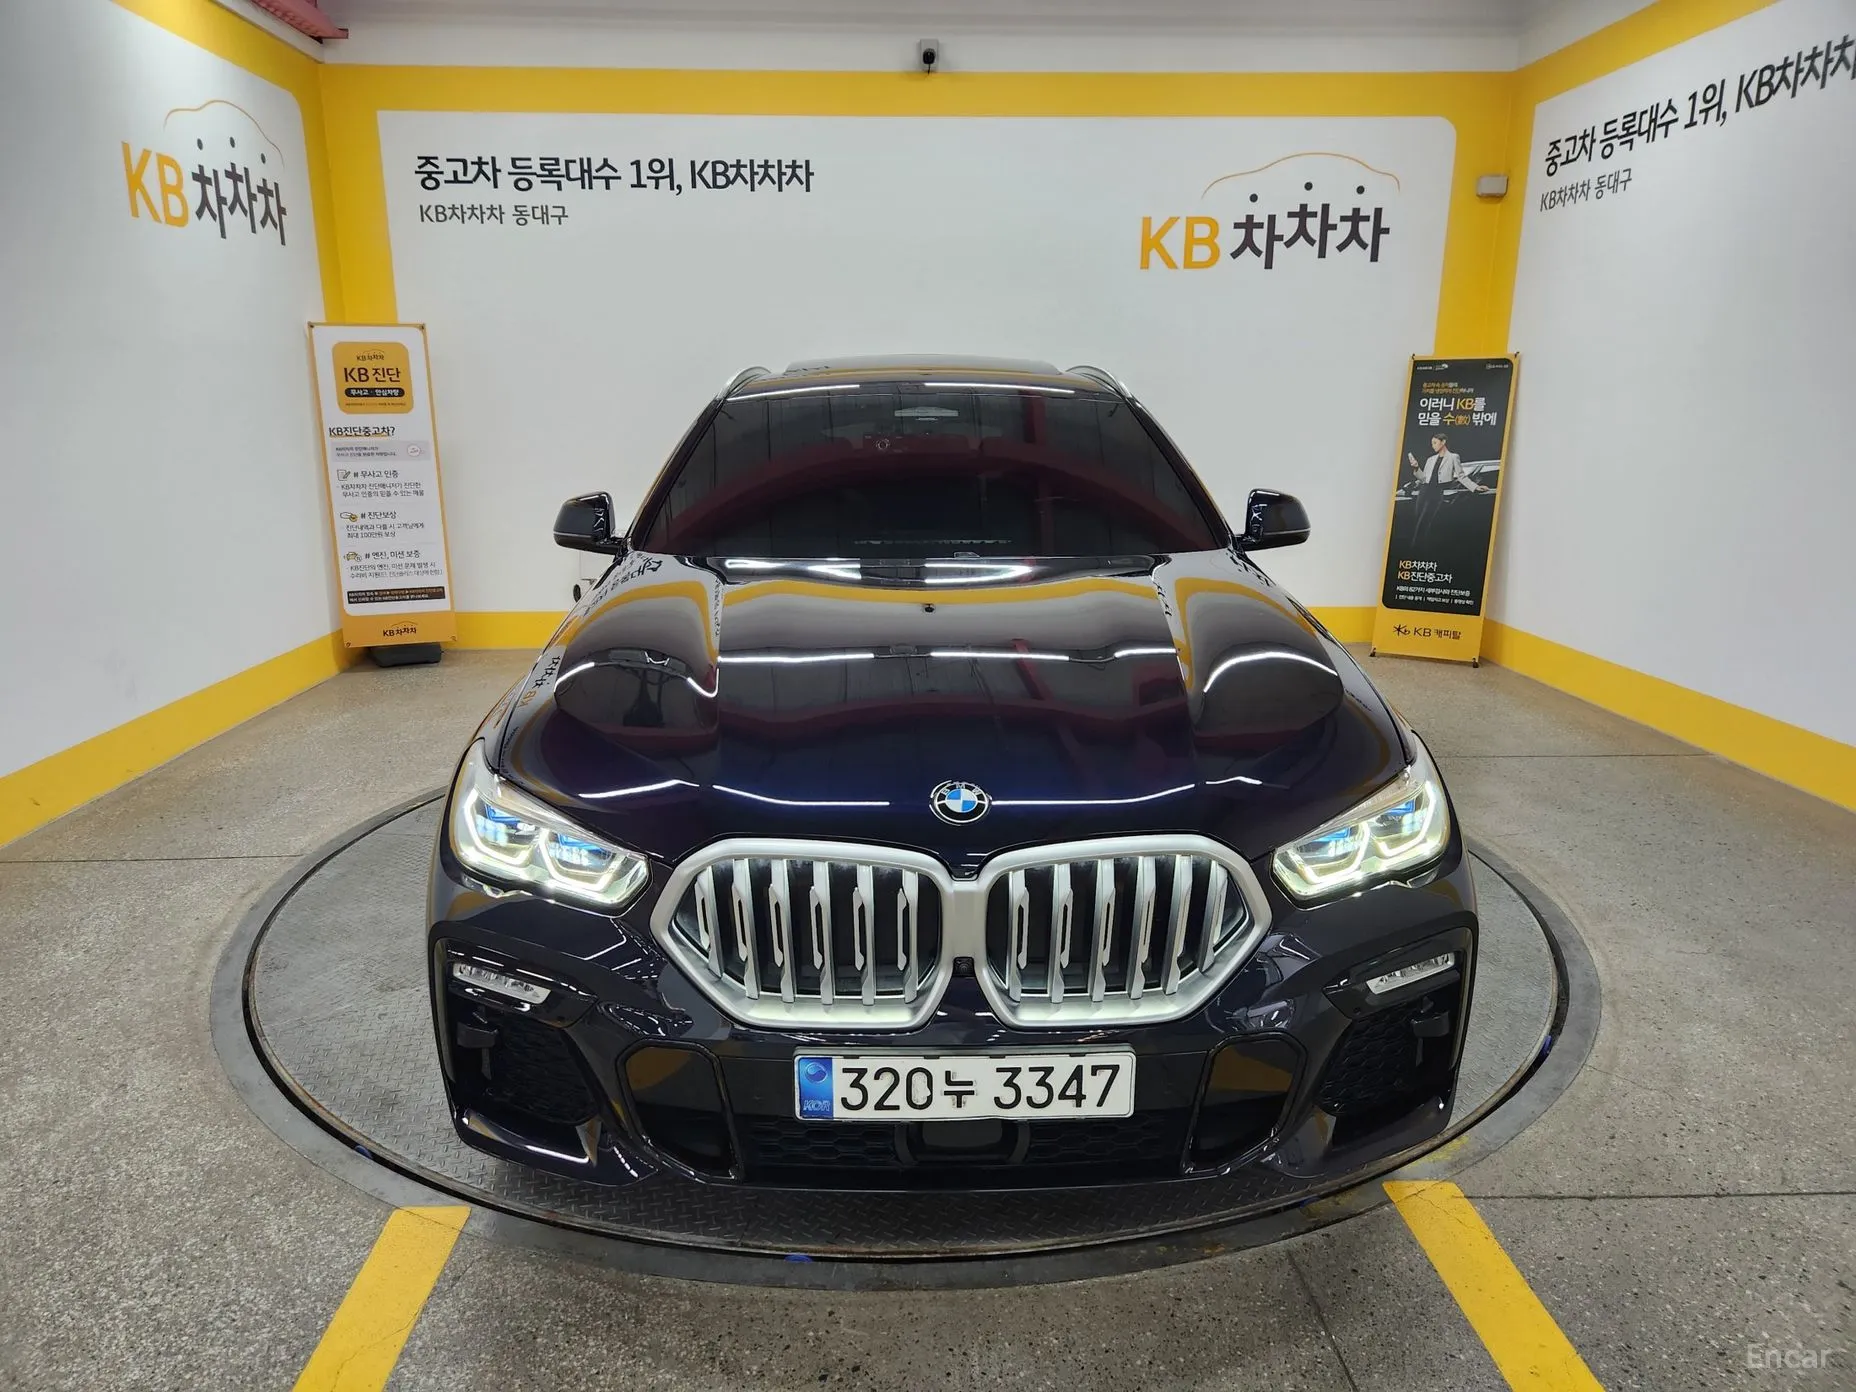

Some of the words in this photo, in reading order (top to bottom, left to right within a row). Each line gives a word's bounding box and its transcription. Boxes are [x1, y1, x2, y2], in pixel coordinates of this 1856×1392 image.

[1545, 125, 1596, 177] 중고차
[1600, 98, 1679, 160] 등록대수
[1683, 78, 1727, 127] 1위,
[414, 156, 502, 191] 중고차
[508, 157, 622, 192] 등록대수
[630, 157, 682, 195] 1위,
[690, 159, 815, 193] KB차차차
[1539, 179, 1591, 212] KB차차차
[1595, 167, 1633, 201] 동대구
[419, 204, 505, 225] KB차차차
[512, 204, 569, 226] 동대구
[344, 367, 369, 383] KB
[372, 367, 401, 383] 진단
[1420, 398, 1455, 411] 이러니
[1456, 397, 1486, 412] KB를
[1418, 412, 1441, 426] 믿을
[1472, 412, 1497, 426] 밖에
[328, 426, 396, 437] KB진단중고차?
[1399, 560, 1437, 571] KB차차차
[1398, 571, 1453, 583] KB진단중고차
[1414, 627, 1432, 637] KB
[840, 1067, 976, 1111] 320누
[994, 1064, 1120, 1109] 3347
